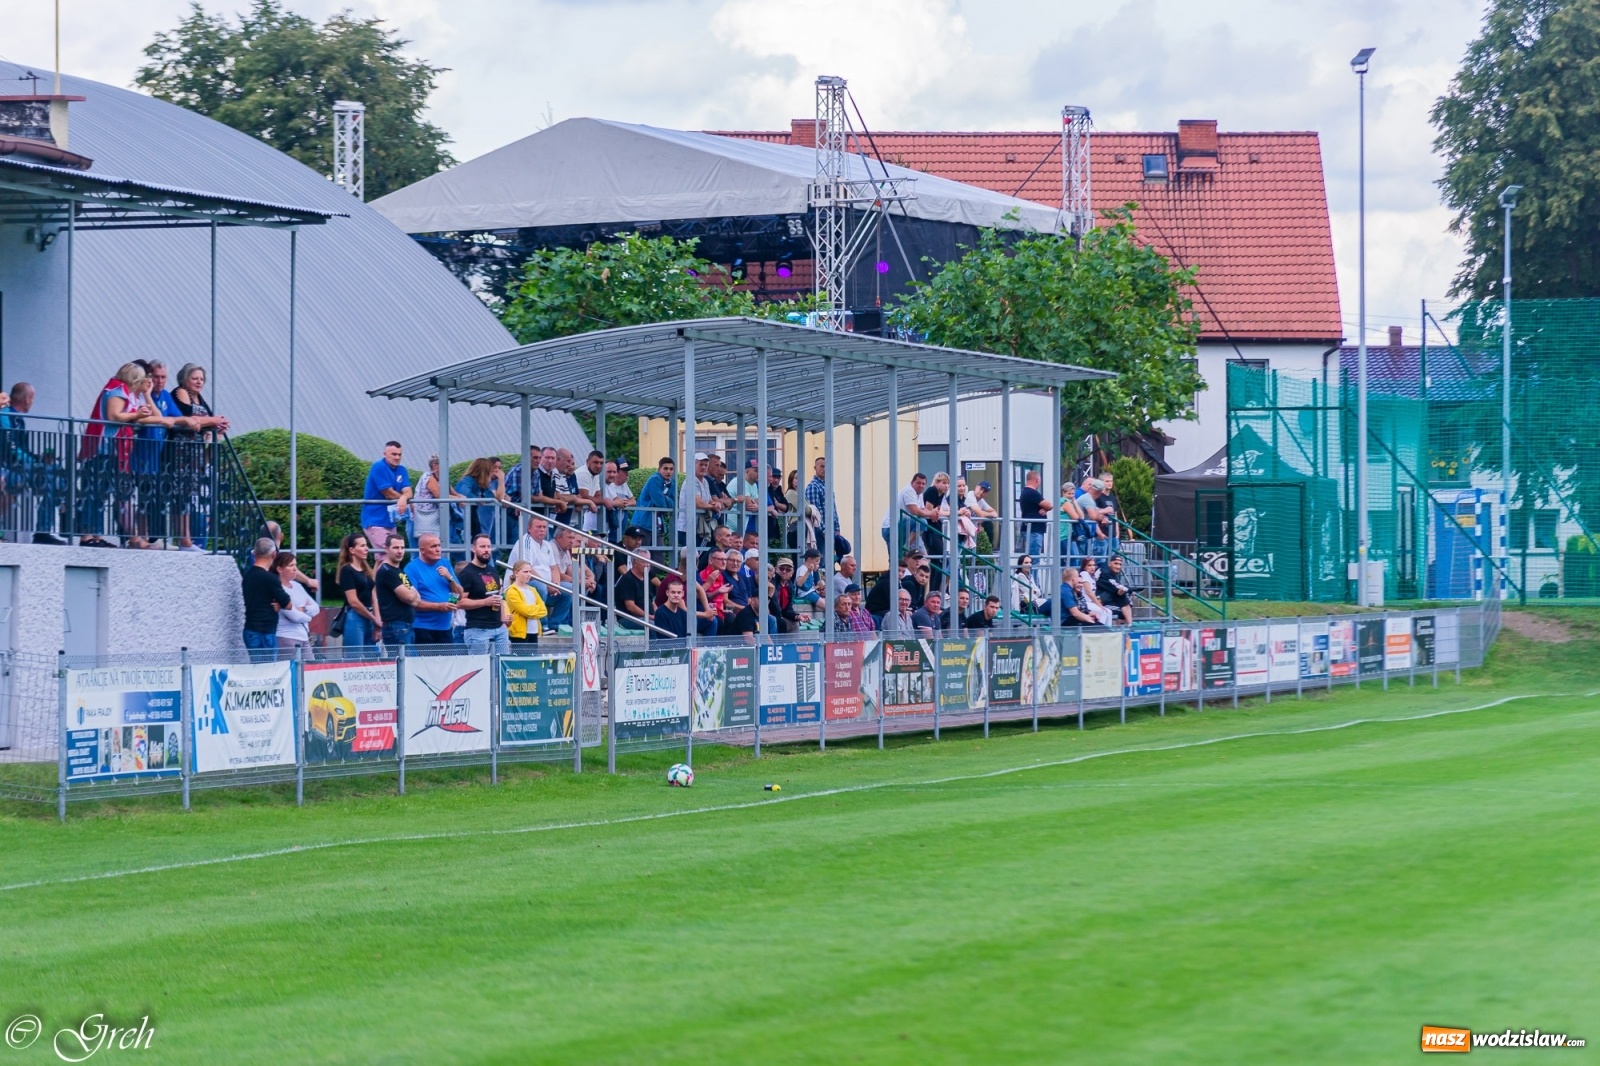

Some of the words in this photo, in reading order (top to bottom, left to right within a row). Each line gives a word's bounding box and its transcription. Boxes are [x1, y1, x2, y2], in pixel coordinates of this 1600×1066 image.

[76, 671, 108, 690] ATRAKCJE
[109, 669, 119, 684] NA
[120, 669, 142, 688] TWOJE
[225, 688, 285, 711] KLIMATRONEX
